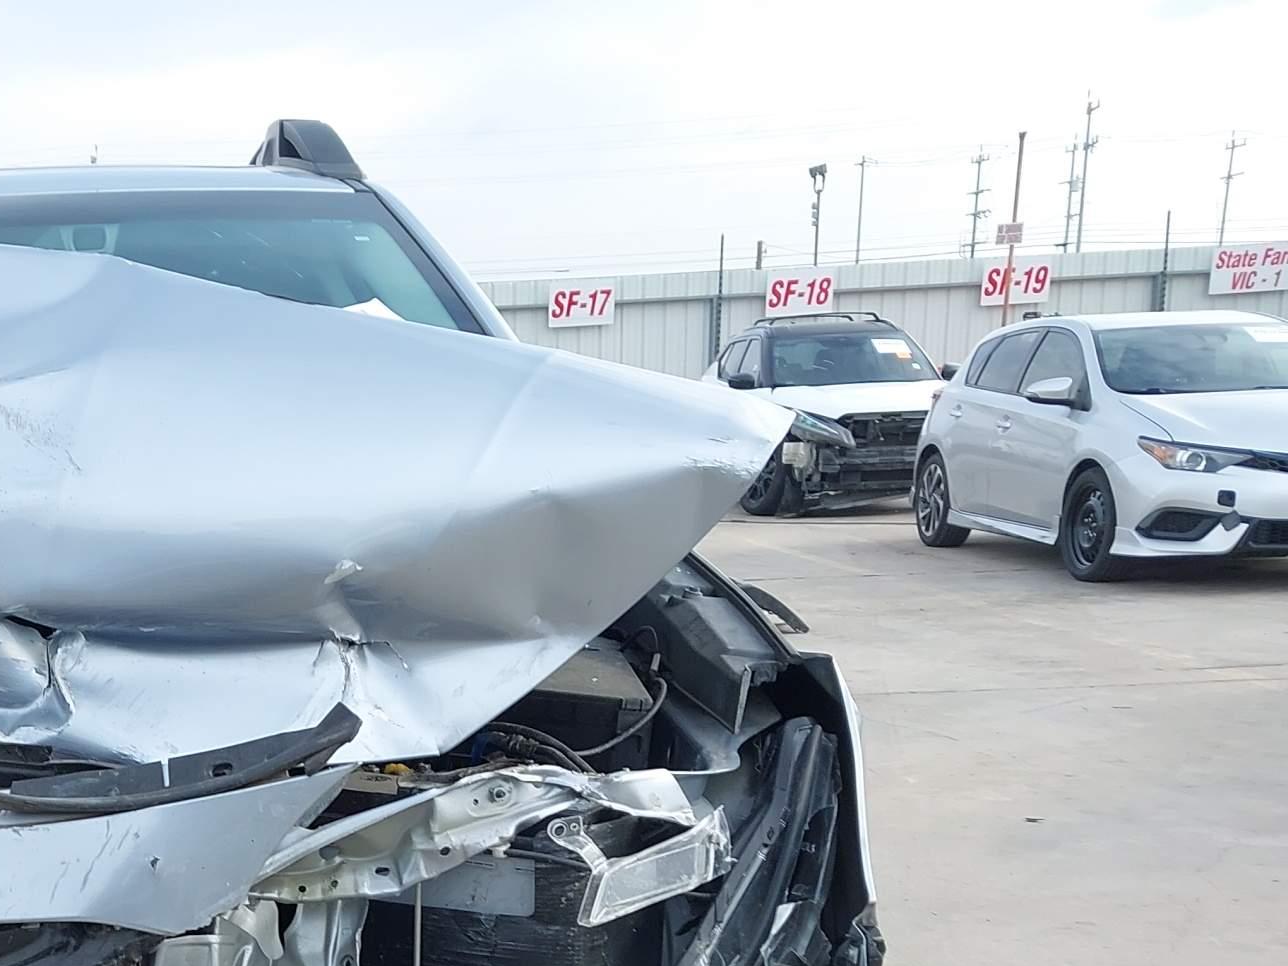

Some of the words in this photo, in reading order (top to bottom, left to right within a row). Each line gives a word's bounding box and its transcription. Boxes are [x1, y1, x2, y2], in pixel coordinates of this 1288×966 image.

[1216, 250, 1258, 269] State
[1262, 248, 1288, 266] Far
[768, 277, 832, 308] SF-18
[984, 265, 1049, 296] SF-19
[1232, 270, 1257, 290] VIC
[1274, 269, 1282, 287] 1
[551, 289, 612, 318] SF-17
